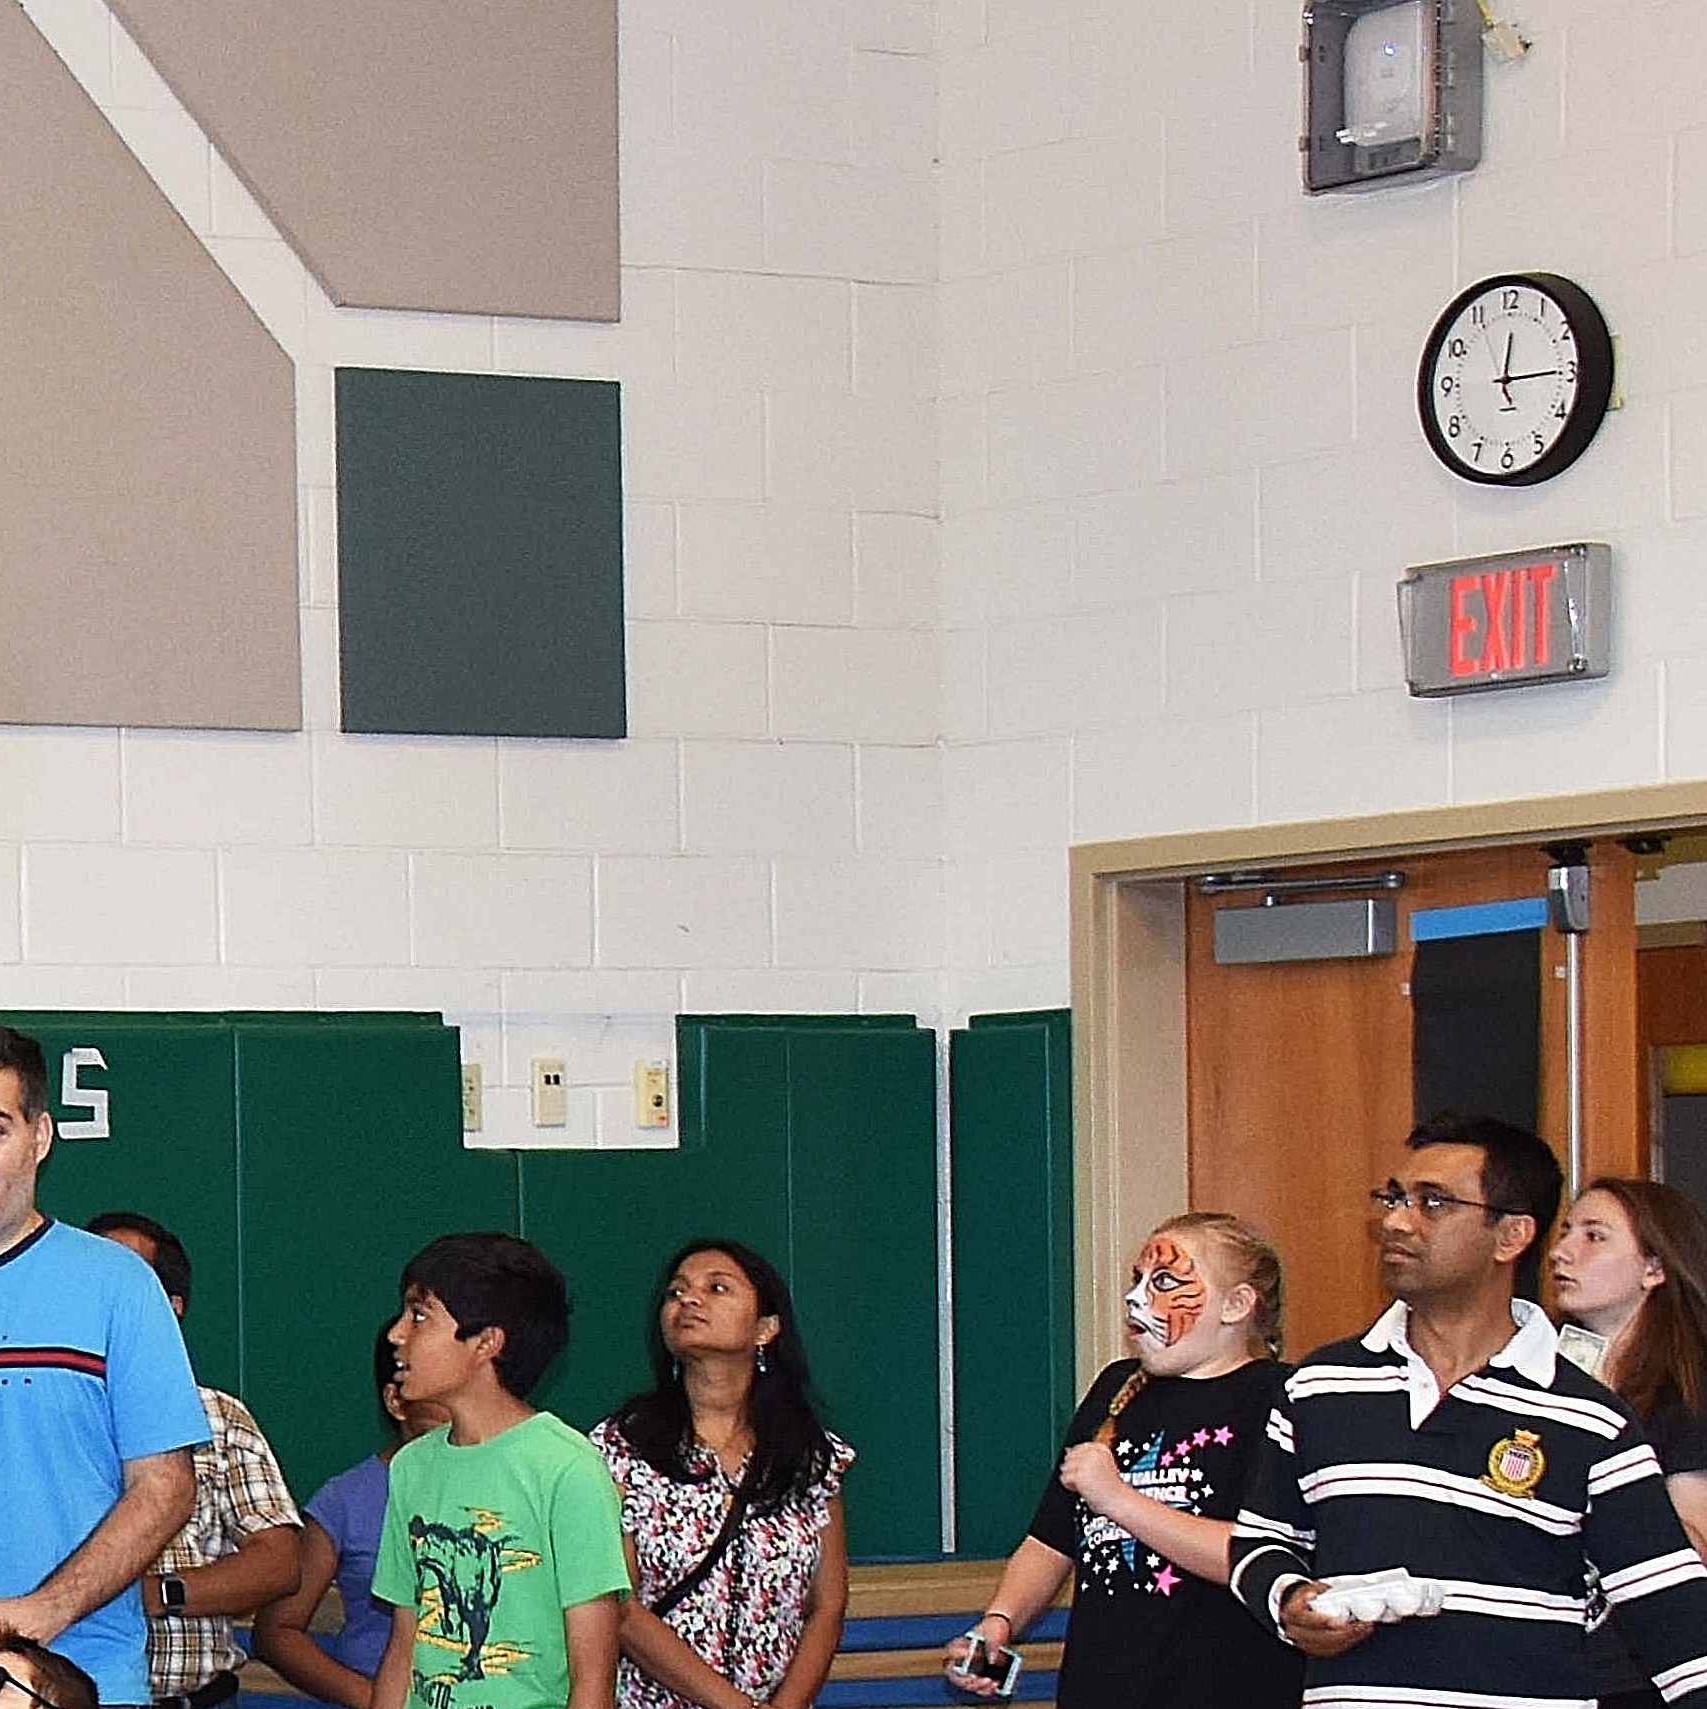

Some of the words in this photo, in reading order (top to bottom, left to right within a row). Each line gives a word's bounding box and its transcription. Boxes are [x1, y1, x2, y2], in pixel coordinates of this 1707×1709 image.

[1502, 290, 1519, 310] 12
[1540, 298, 1545, 317] 1
[1472, 305, 1484, 325] 11
[1560, 320, 1570, 341] 2
[1448, 338, 1464, 358] 10
[1562, 361, 1576, 383] 3
[1441, 376, 1454, 398] 9
[1554, 401, 1566, 420] 4
[1448, 415, 1460, 438] 8
[1472, 442, 1482, 462] 7
[1531, 435, 1544, 455] 5
[1500, 447, 1514, 469] 6
[1450, 565, 1557, 677] EXIT
